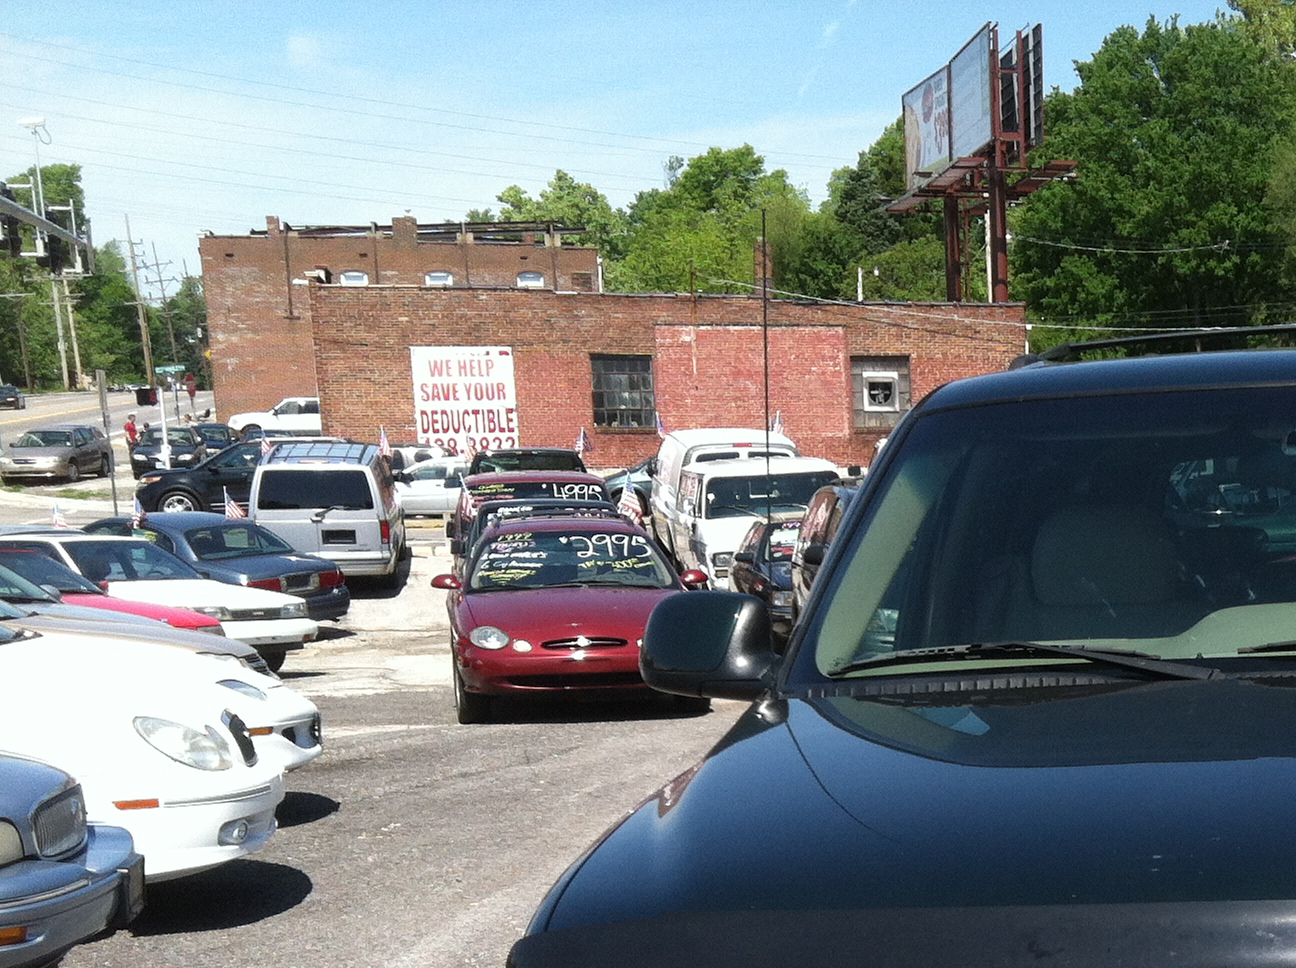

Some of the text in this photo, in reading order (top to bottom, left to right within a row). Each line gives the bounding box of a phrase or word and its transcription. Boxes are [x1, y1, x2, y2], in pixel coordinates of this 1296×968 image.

[428, 359, 494, 377] WE HELP
[420, 382, 506, 402] SAVE YOUR
[420, 408, 515, 434] DEDUCTIBLE
